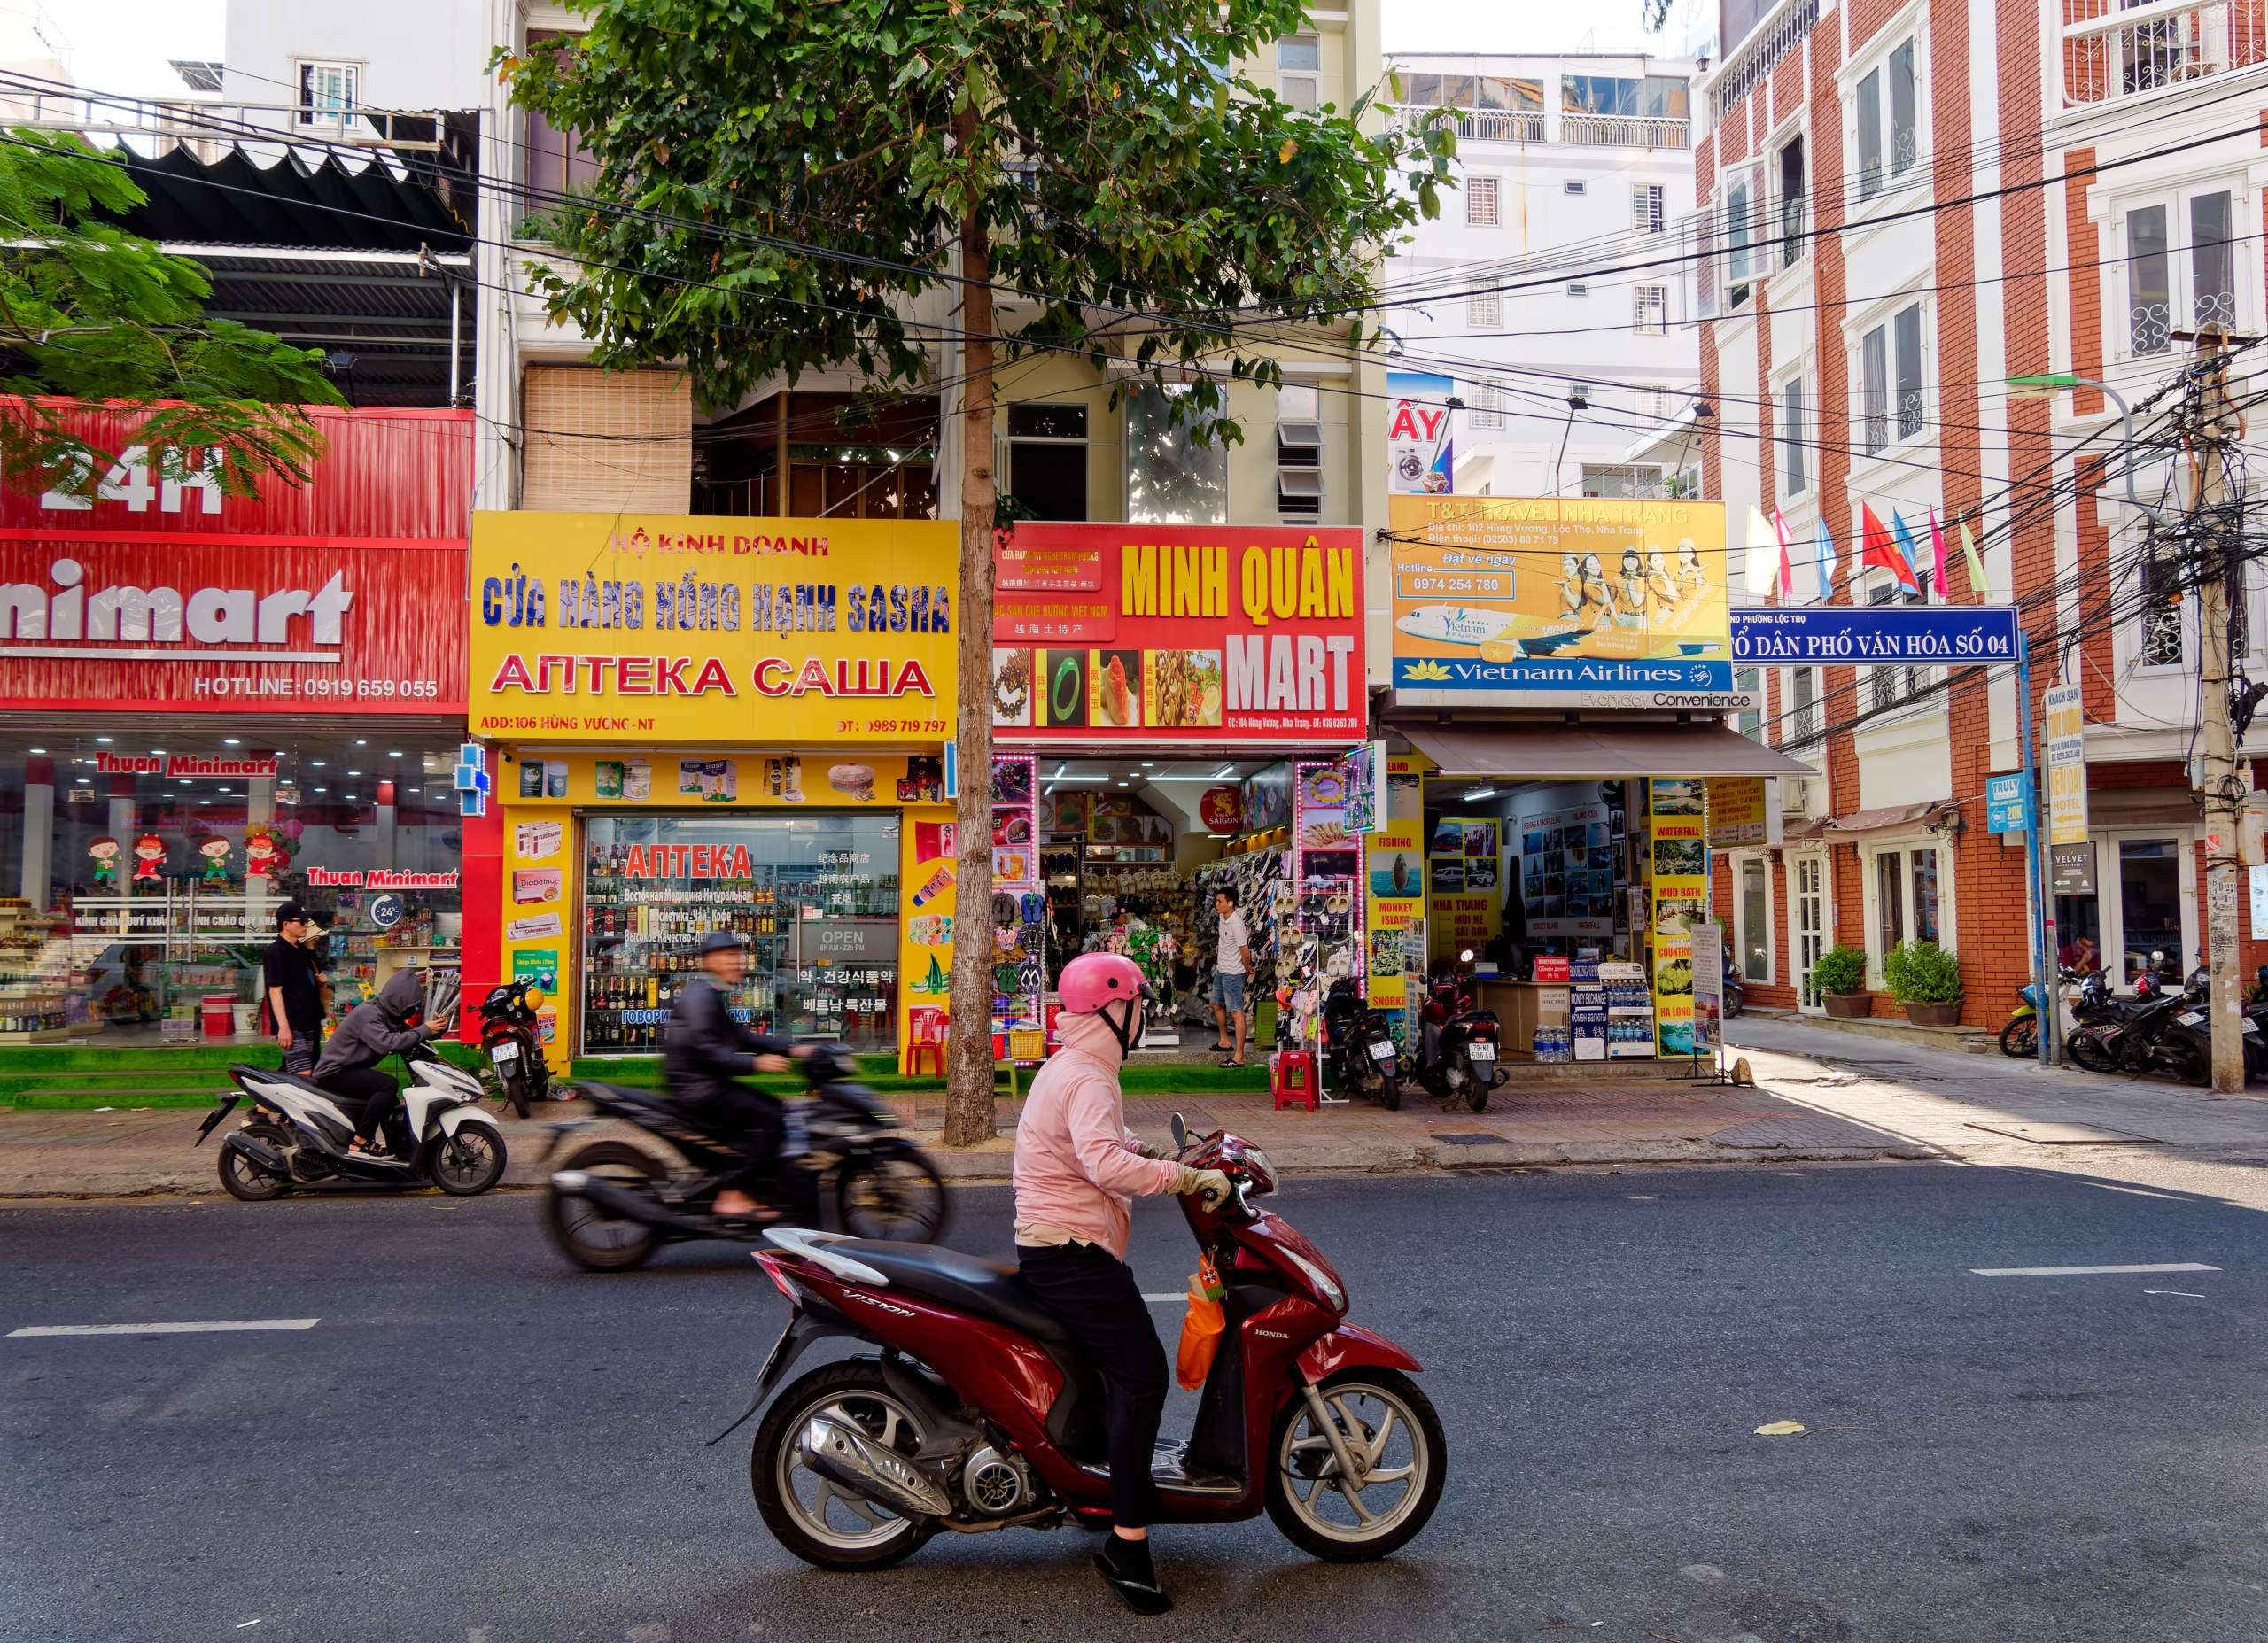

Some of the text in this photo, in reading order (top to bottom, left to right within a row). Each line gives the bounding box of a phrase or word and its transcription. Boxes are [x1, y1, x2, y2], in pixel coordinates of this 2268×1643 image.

[40, 443, 223, 514] 24H
[1426, 501, 1689, 524] T&T TRAVEL NHA TRANG
[1467, 523, 1484, 532] 102
[1487, 523, 1512, 534] Hùng
[1513, 523, 1550, 535] Vương,
[1553, 523, 1572, 534] Lộc
[1596, 525, 1616, 534] Nha
[1619, 526, 1645, 537] Trang
[610, 526, 828, 560] HỘ KINH DOANH
[1428, 532, 1559, 546] Điện thoại: (02583) 88 71 79
[1442, 553, 1518, 568] Đặt vé ngay
[1397, 563, 1433, 573] Hotline
[1121, 534, 1355, 626] MINH QUÂN
[1413, 578, 1499, 591] 0974 254 780
[483, 562, 951, 639] CỬA HÀNG HỒNG HẠNH SASHA
[1090, 604, 1109, 617] NAM
[1774, 613, 1790, 625] LỘC
[1790, 614, 1806, 624] THỌ
[1014, 624, 1084, 634] 越南土特产
[1755, 630, 1801, 656] DÂN
[1806, 626, 1852, 656] PHỐ
[1856, 630, 1901, 656] VĂN
[1906, 629, 1952, 655] HÓA
[1955, 625, 1984, 655] SỐ
[1987, 635, 2009, 655] 04
[489, 653, 936, 698] АПТЕКА САША
[1225, 634, 1355, 712] MART
[1455, 663, 1682, 682] Vietnam Airlines
[194, 677, 438, 698] HOTLINE: 0919 659 055
[1580, 692, 1751, 710] Everyday Convenience
[540, 713, 578, 730] HÙNG
[864, 719, 897, 732] 0989
[900, 720, 920, 732] 719
[924, 720, 947, 732] 797
[95, 751, 278, 779] Thuan Minimart
[1992, 779, 2020, 794] TRULY
[2049, 768, 2067, 797] NEW
[2053, 798, 2081, 812] HOTEL
[1656, 826, 1700, 838] WATERFALL
[1378, 837, 1412, 848] FISHING
[624, 843, 753, 879] АПТЕКА
[817, 852, 870, 864] 纪念品商店
[2054, 854, 2088, 864] VELVET
[307, 865, 459, 889] Thuan Minimart
[818, 873, 870, 885] 越南农产品
[625, 887, 664, 902] Восточная
[830, 893, 852, 904] 香烟
[1658, 887, 1701, 897] MUD BATH
[1379, 903, 1413, 912] MONKEY
[1432, 899, 1488, 911] NHA TRANG
[75, 914, 97, 926] KÍNH
[127, 913, 144, 926] QUÝ
[211, 912, 237, 926] CHÀO
[821, 931, 865, 944] OPEN
[803, 998, 887, 1012] 베트남 특산물
[1571, 993, 1607, 1004] MONEY EXCHANGE
[1660, 1006, 1691, 1017] HA LONG
[841, 1288, 917, 1318] VISION
[1254, 1329, 1290, 1339] HONDA
